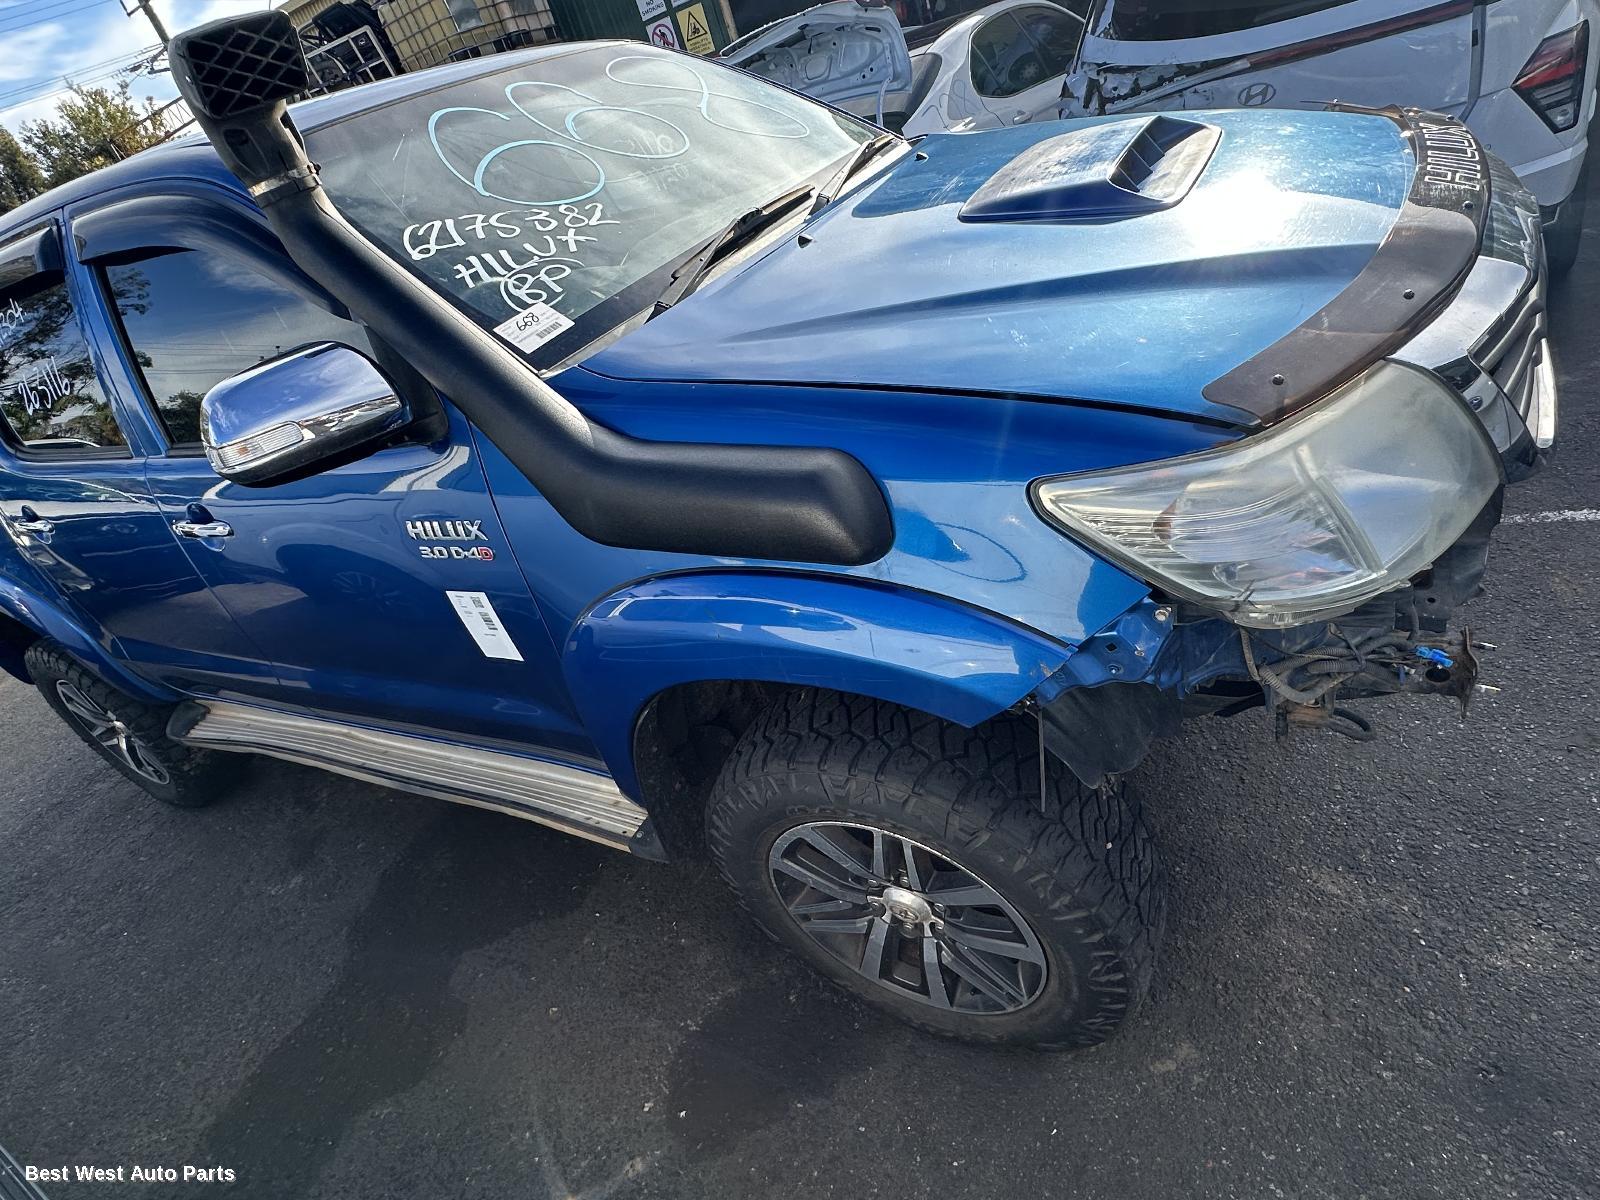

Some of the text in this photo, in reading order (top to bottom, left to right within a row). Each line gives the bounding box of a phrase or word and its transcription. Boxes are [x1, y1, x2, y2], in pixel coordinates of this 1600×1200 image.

[641, 2, 665, 16] SMOKING
[1418, 122, 1481, 191] HILUX
[405, 519, 489, 541] HILUX
